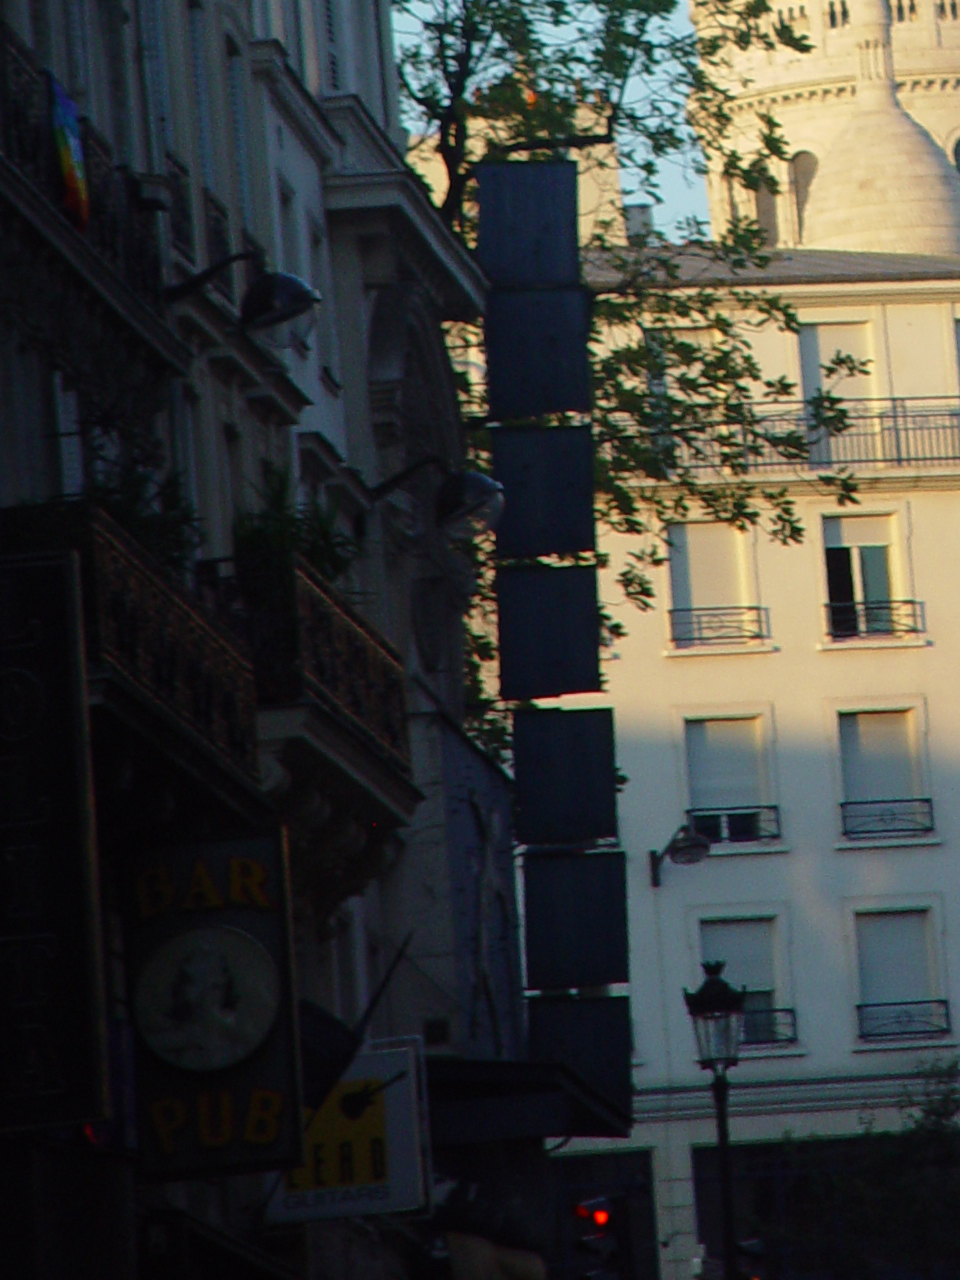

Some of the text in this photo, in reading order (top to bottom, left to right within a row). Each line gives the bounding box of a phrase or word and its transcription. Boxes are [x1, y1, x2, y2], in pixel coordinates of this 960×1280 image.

[136, 855, 270, 918] BAR
[151, 1087, 283, 1155] PUB
[282, 1184, 390, 1210] GUITARS
